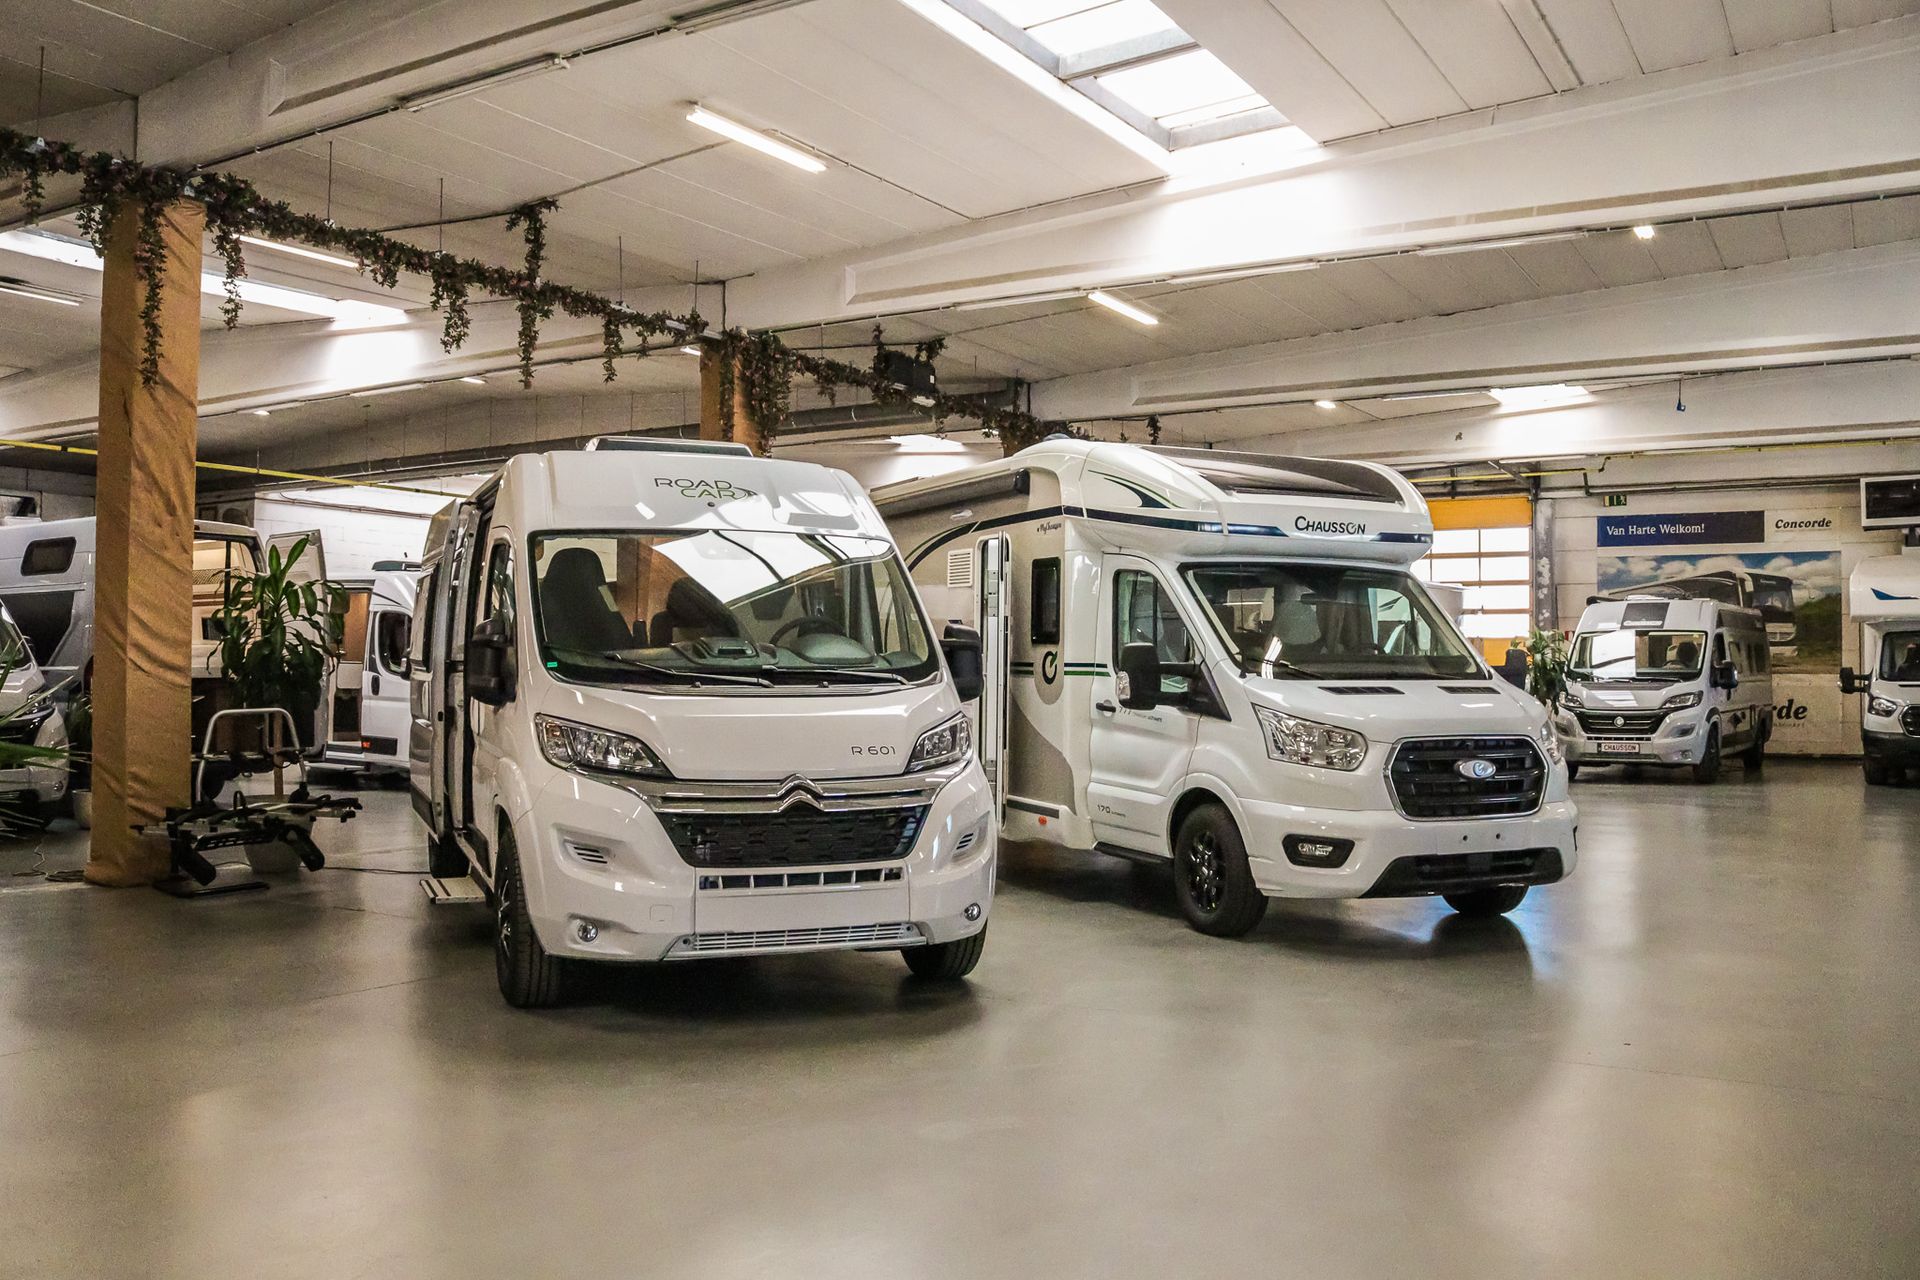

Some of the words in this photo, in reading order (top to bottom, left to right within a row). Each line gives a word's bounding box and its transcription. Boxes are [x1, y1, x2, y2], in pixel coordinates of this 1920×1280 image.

[654, 478, 733, 490] ROAD
[680, 488, 740, 500] CAR
[1775, 517, 1832, 529] Concorde
[1606, 525, 1626, 536] Van
[1628, 525, 1657, 535] Harte
[1659, 523, 1705, 534] Welkom!
[851, 745, 863, 755] R
[867, 745, 896, 755] 601
